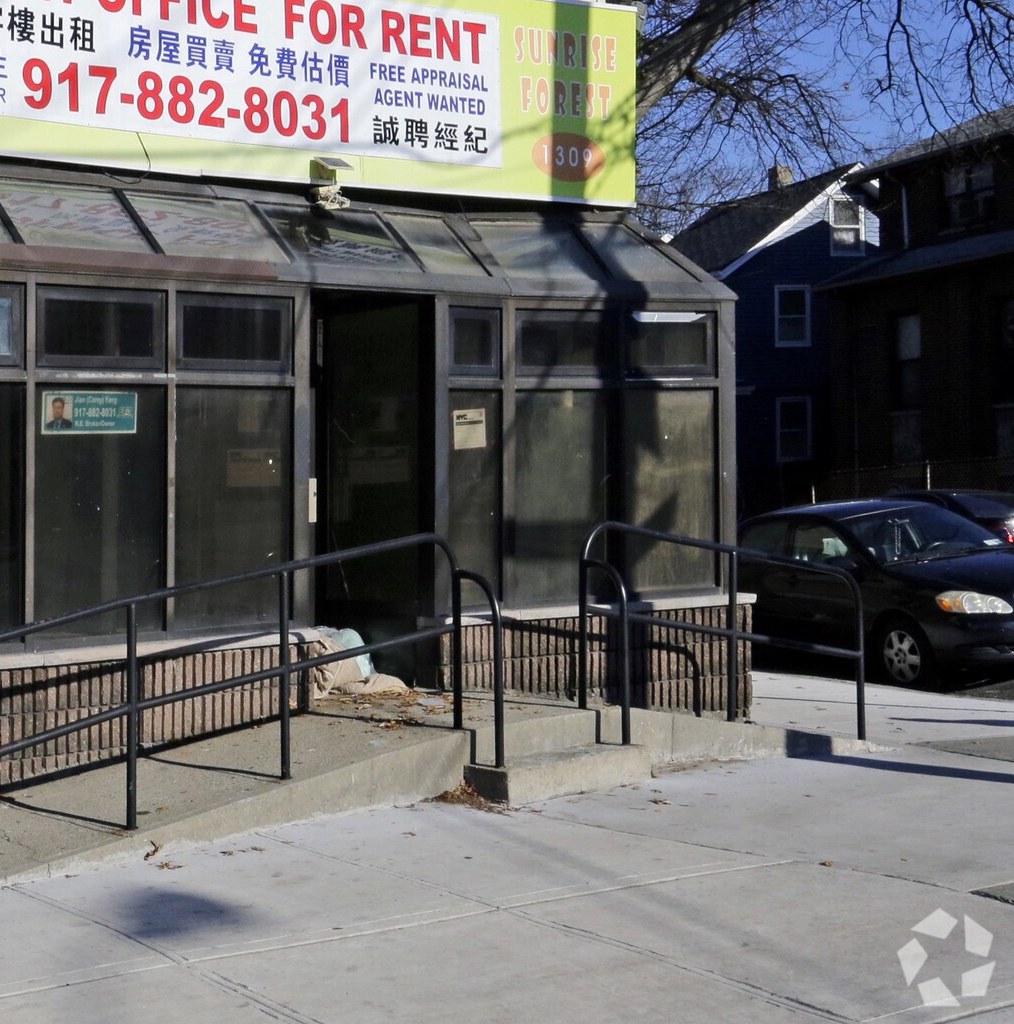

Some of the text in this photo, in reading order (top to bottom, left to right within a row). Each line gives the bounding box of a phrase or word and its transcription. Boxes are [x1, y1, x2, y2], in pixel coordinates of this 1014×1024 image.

[128, 25, 349, 88] 房屋買賣 免費估價
[381, 9, 487, 64] RENT
[514, 26, 617, 72] SUNRISE
[370, 62, 488, 92] FREE APPRAISAL
[22, 58, 349, 143] 917-882-8031
[374, 88, 485, 116] AGENT WANTED
[521, 76, 611, 120] FOREST
[373, 115, 488, 154] 誠聘經紀
[543, 144, 593, 168] 1309
[74, 407, 116, 417] 917-882-8031
